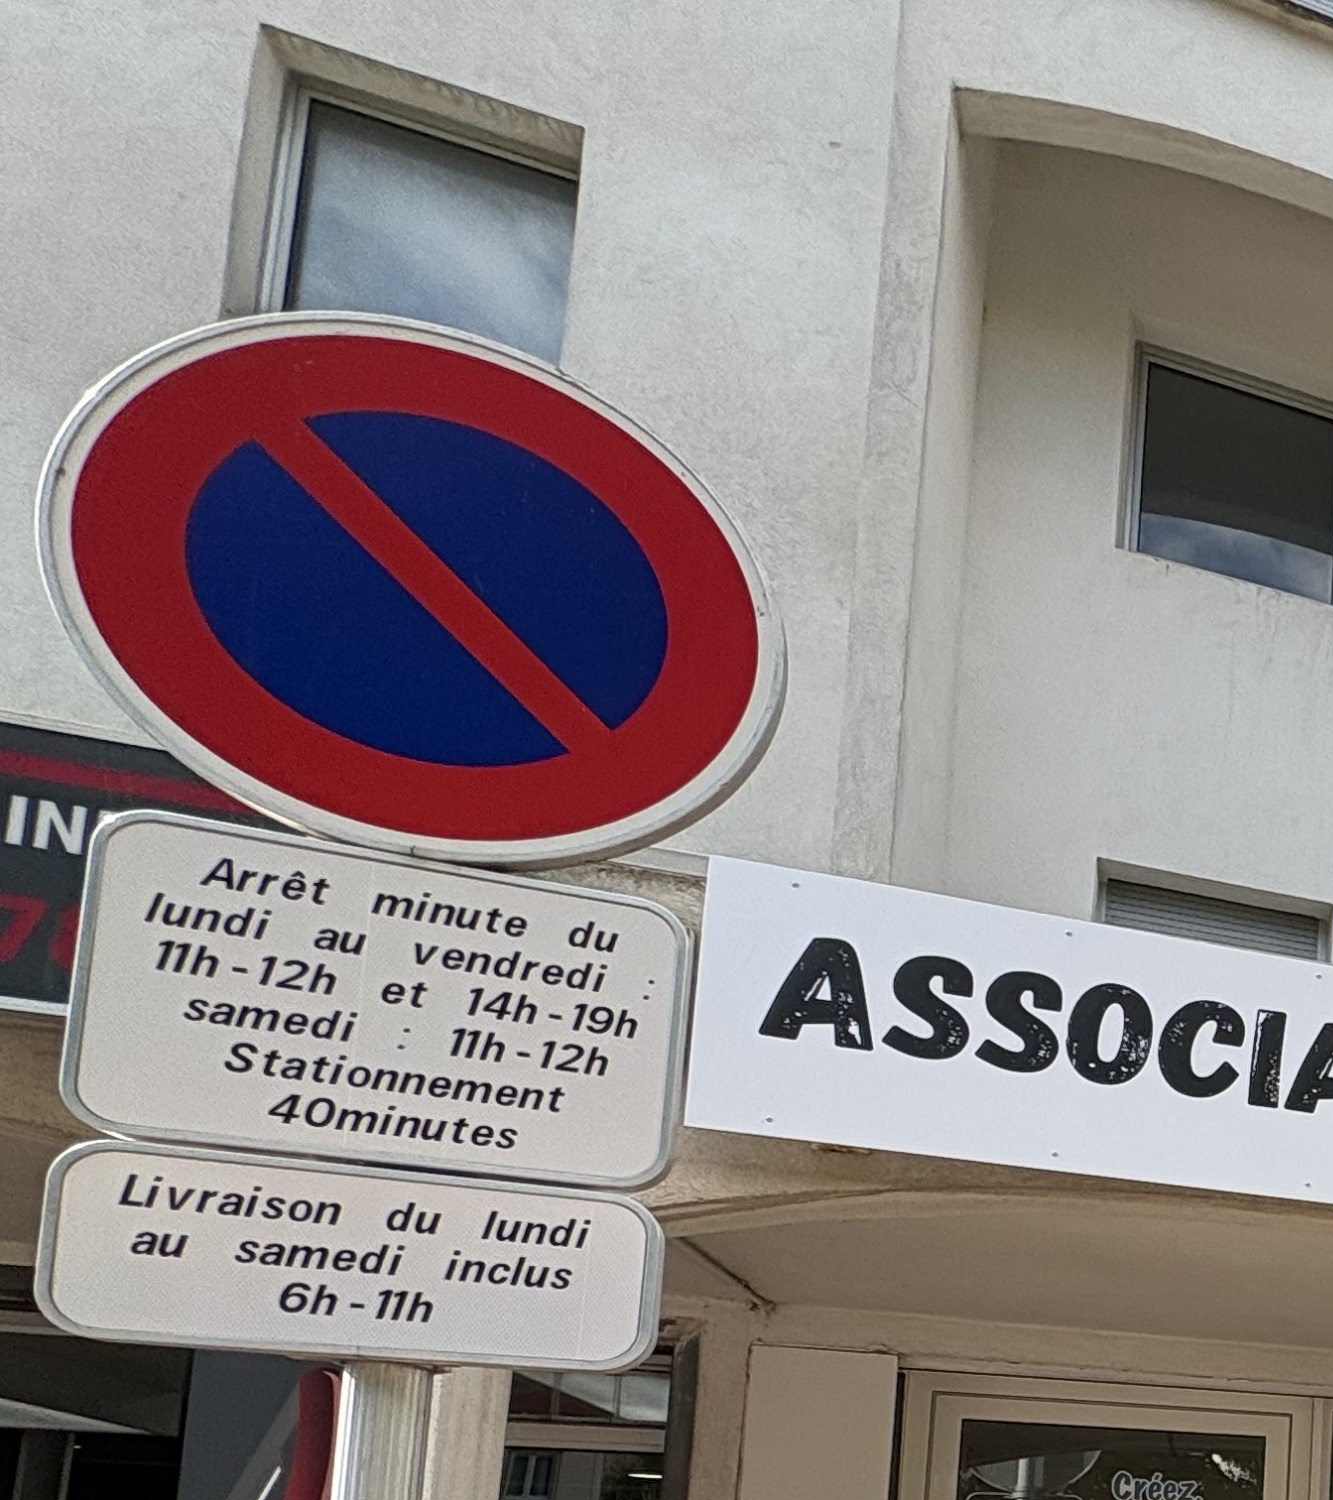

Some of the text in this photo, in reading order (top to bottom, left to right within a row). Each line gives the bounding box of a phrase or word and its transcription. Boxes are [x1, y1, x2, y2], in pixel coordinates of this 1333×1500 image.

[5, 795, 110, 855] IN
[200, 858, 620, 954] Arrêt minute du
[145, 893, 271, 940] lundi
[314, 926, 366, 955] au
[414, 939, 607, 993] vendredi
[184, 996, 356, 1042] samedi
[381, 977, 426, 1008] et
[224, 1043, 566, 1113] Stationnement
[268, 1095, 519, 1150] 40minutes
[118, 1174, 591, 1249] Livraison du lundi
[131, 1230, 573, 1290] au samedi inclus
